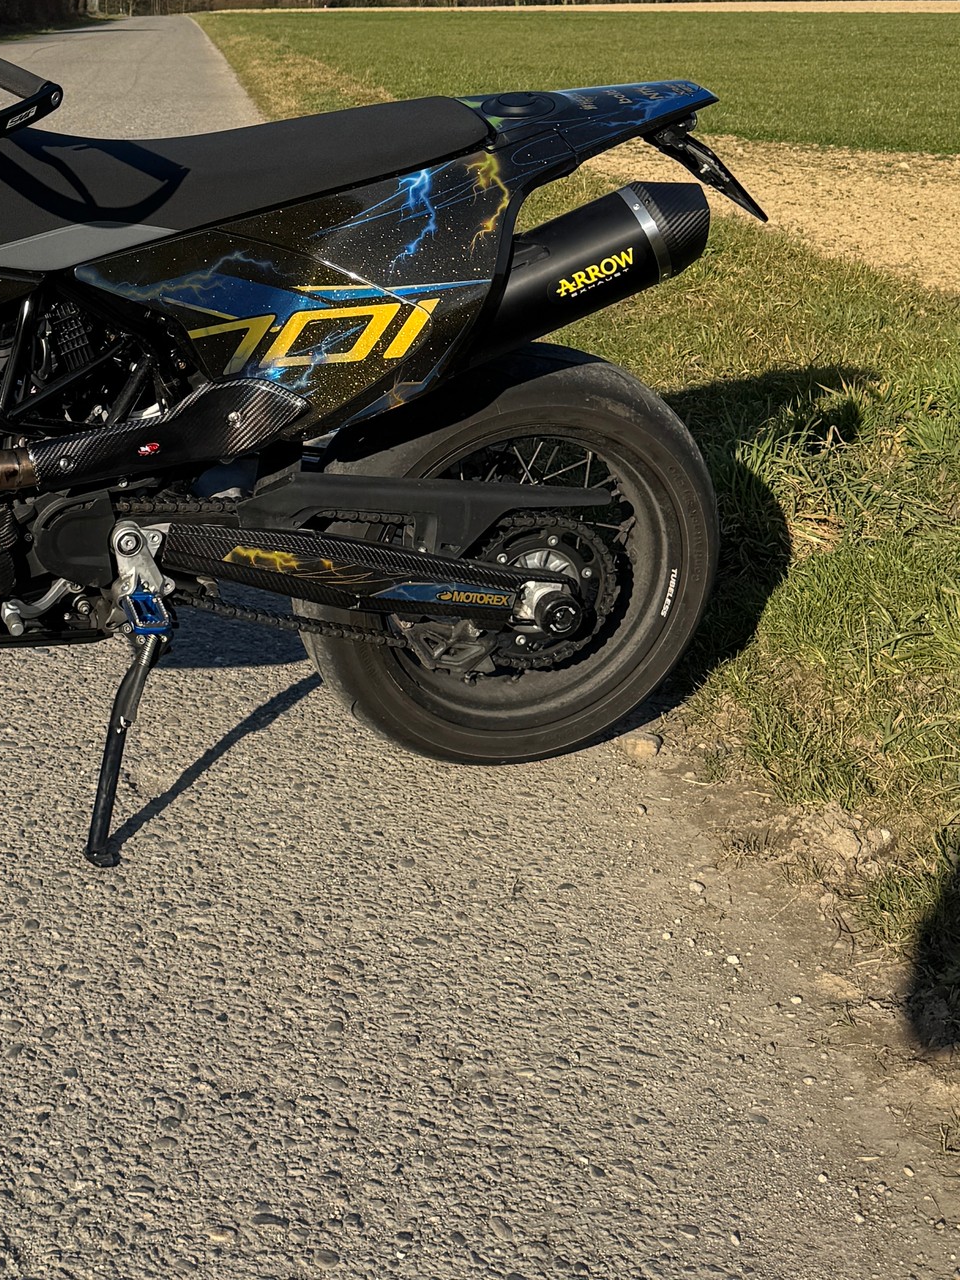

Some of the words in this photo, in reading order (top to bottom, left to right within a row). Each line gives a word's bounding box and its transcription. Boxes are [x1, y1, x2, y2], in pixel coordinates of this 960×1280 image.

[555, 247, 633, 297] ARROW
[187, 297, 440, 376] 701
[452, 590, 510, 606] MOTOREX
[660, 568, 678, 618] TUBELESS
